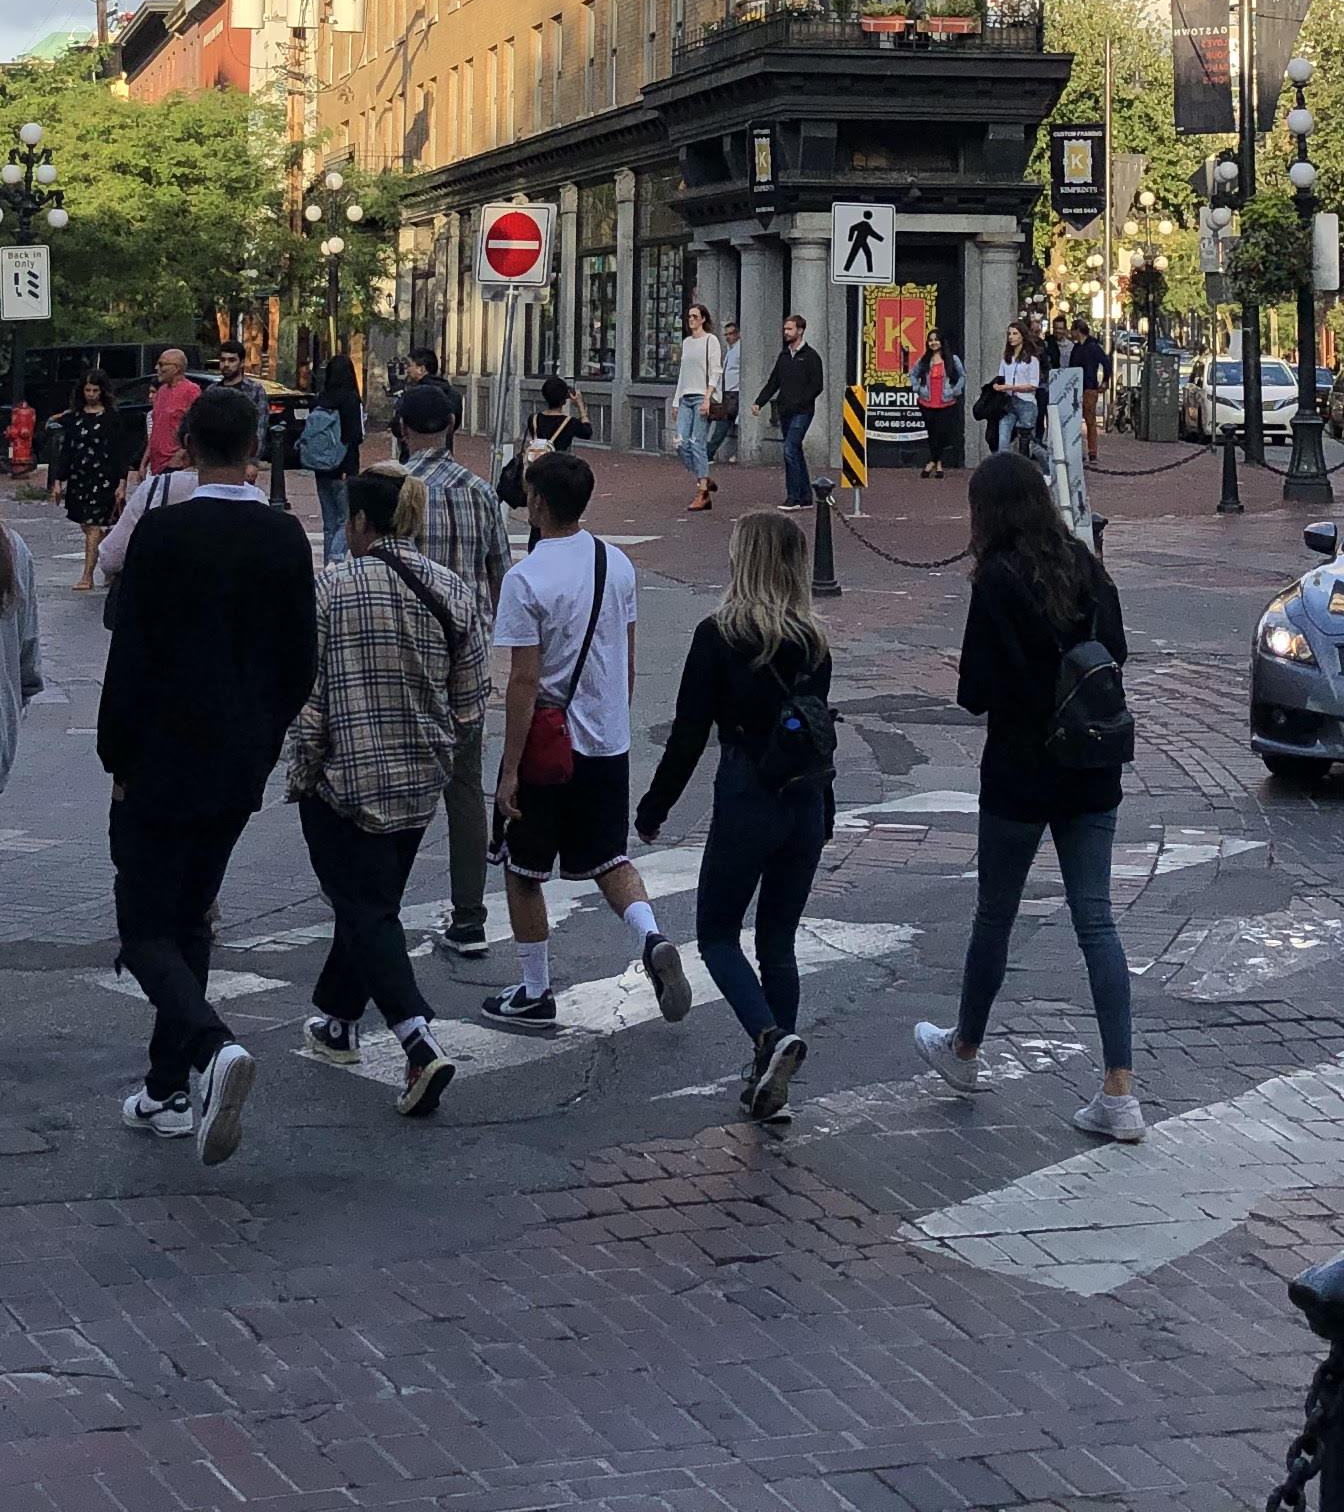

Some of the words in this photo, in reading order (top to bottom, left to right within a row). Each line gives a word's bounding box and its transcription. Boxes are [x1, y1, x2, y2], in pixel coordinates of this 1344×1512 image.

[759, 152, 768, 167] K
[1071, 154, 1084, 169] K
[8, 251, 29, 259] Back
[14, 260, 34, 269] Only
[884, 317, 917, 352] K
